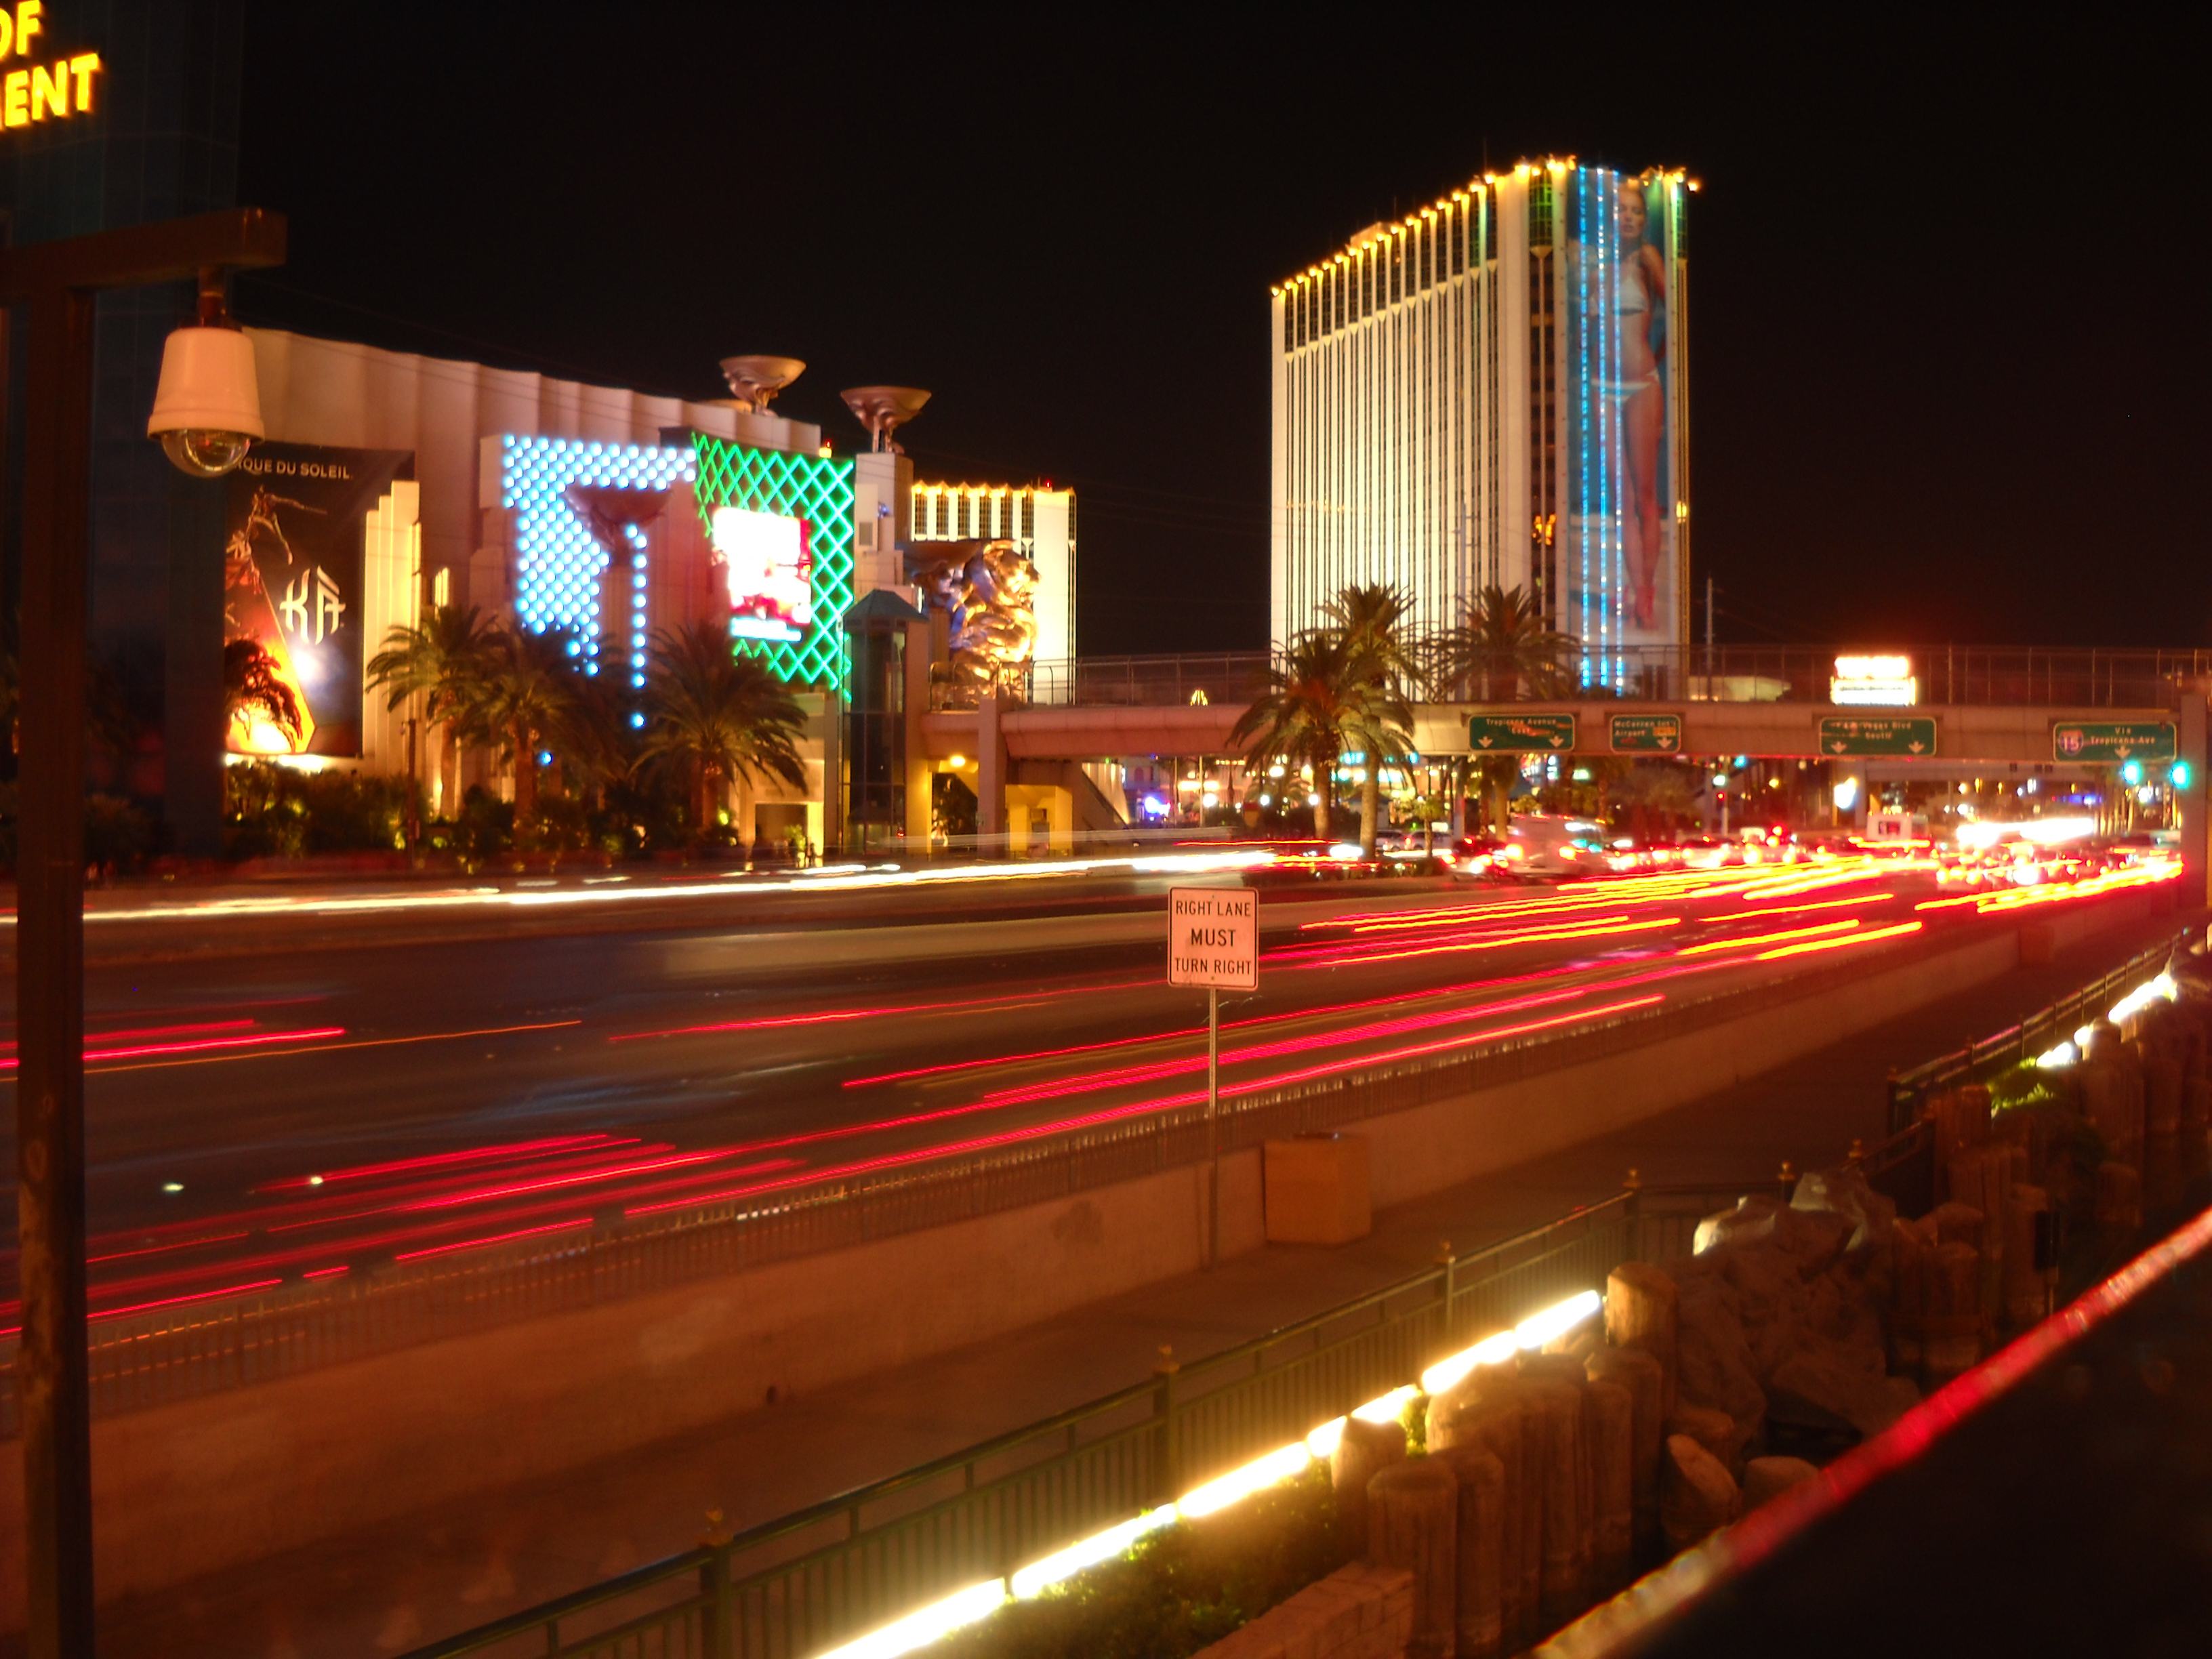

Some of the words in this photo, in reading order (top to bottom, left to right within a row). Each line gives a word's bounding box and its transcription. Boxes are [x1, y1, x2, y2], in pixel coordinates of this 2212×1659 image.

[0, 53, 98, 127] ENT
[236, 457, 272, 474] QUE
[276, 461, 296, 475] DU
[300, 462, 350, 479] SOLEIL
[2064, 737, 2080, 751] 15
[2091, 736, 2134, 745] Tropicana
[1176, 901, 1212, 915] RIGHT
[1217, 902, 1251, 917] LANE
[1191, 928, 1236, 947] MUST
[1175, 958, 1208, 972] TURN
[1214, 959, 1251, 975] RIGHT
